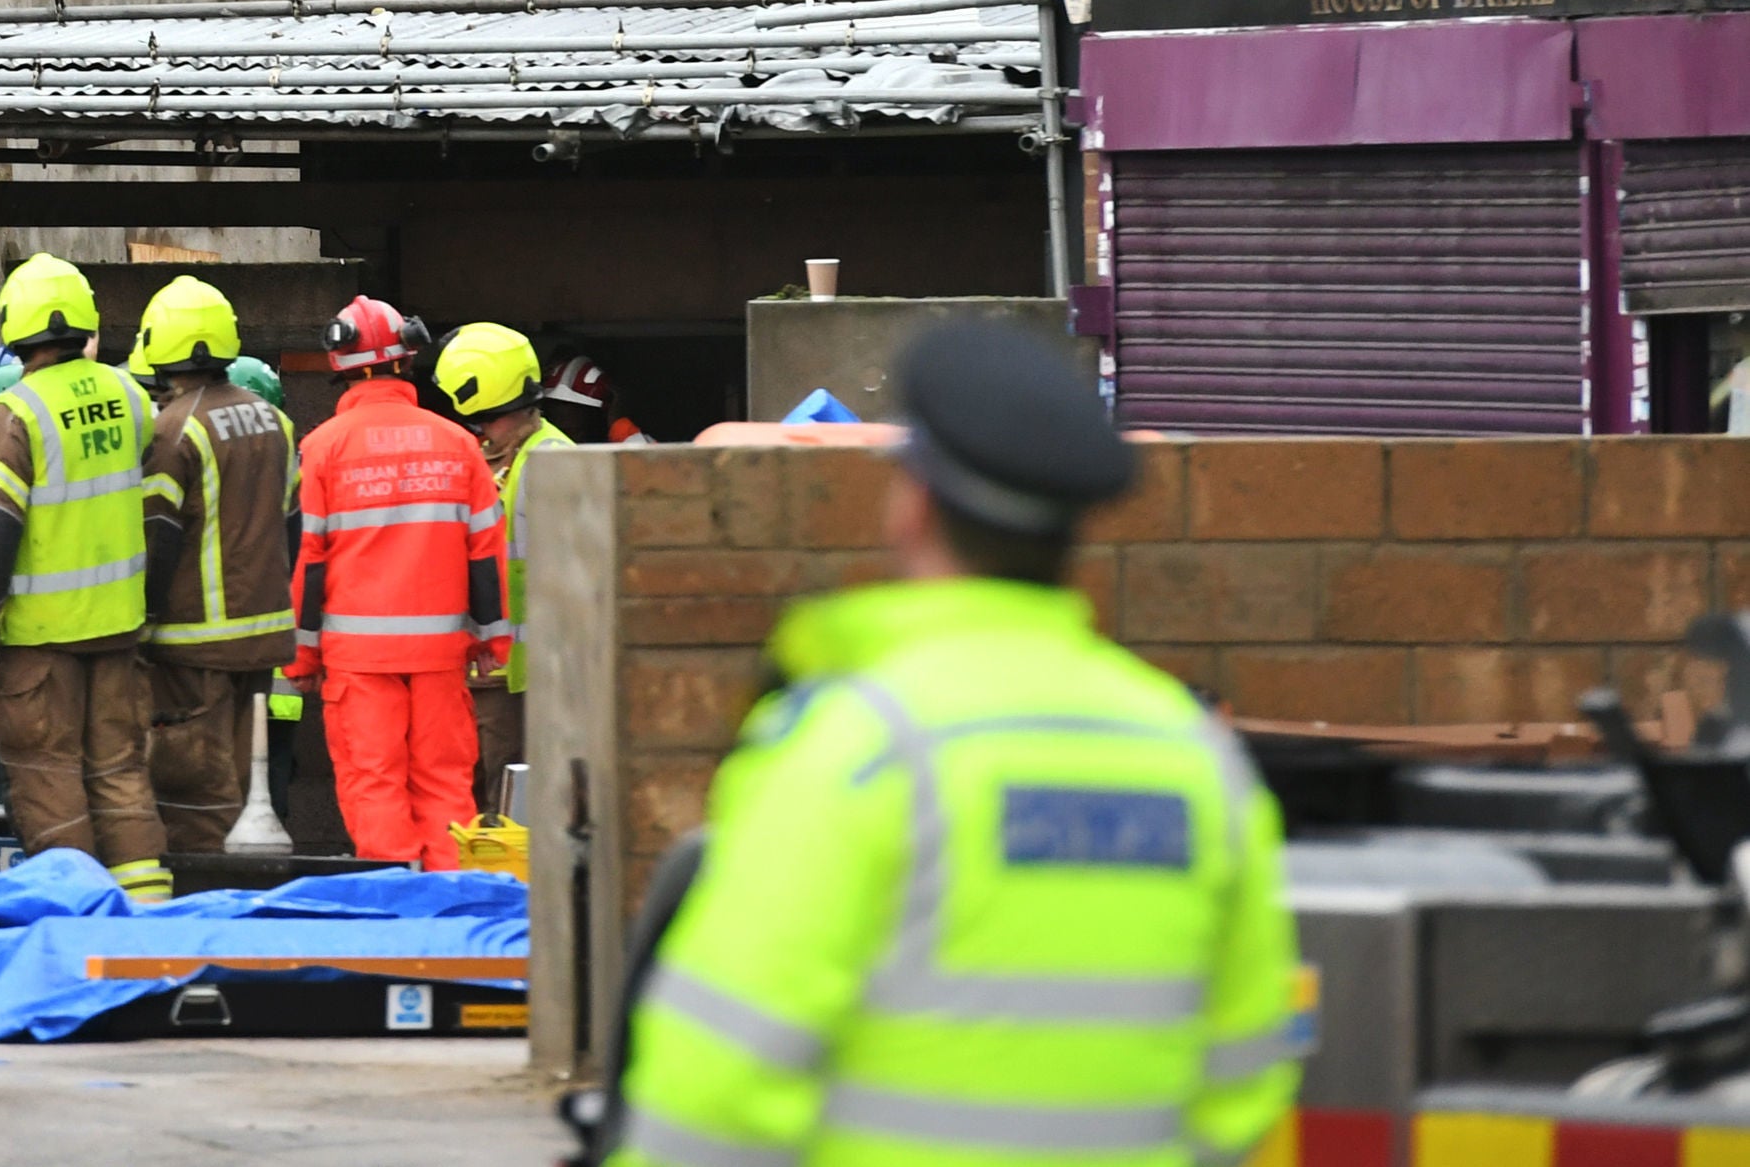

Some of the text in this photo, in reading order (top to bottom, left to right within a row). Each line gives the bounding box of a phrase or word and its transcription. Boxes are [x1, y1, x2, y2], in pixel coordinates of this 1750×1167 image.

[59, 399, 125, 430] FIRE
[207, 401, 279, 441] FIRE
[80, 425, 122, 459] FRU
[342, 461, 463, 483] URBAN SEARCH
[356, 476, 450, 497] AND RESCUE
